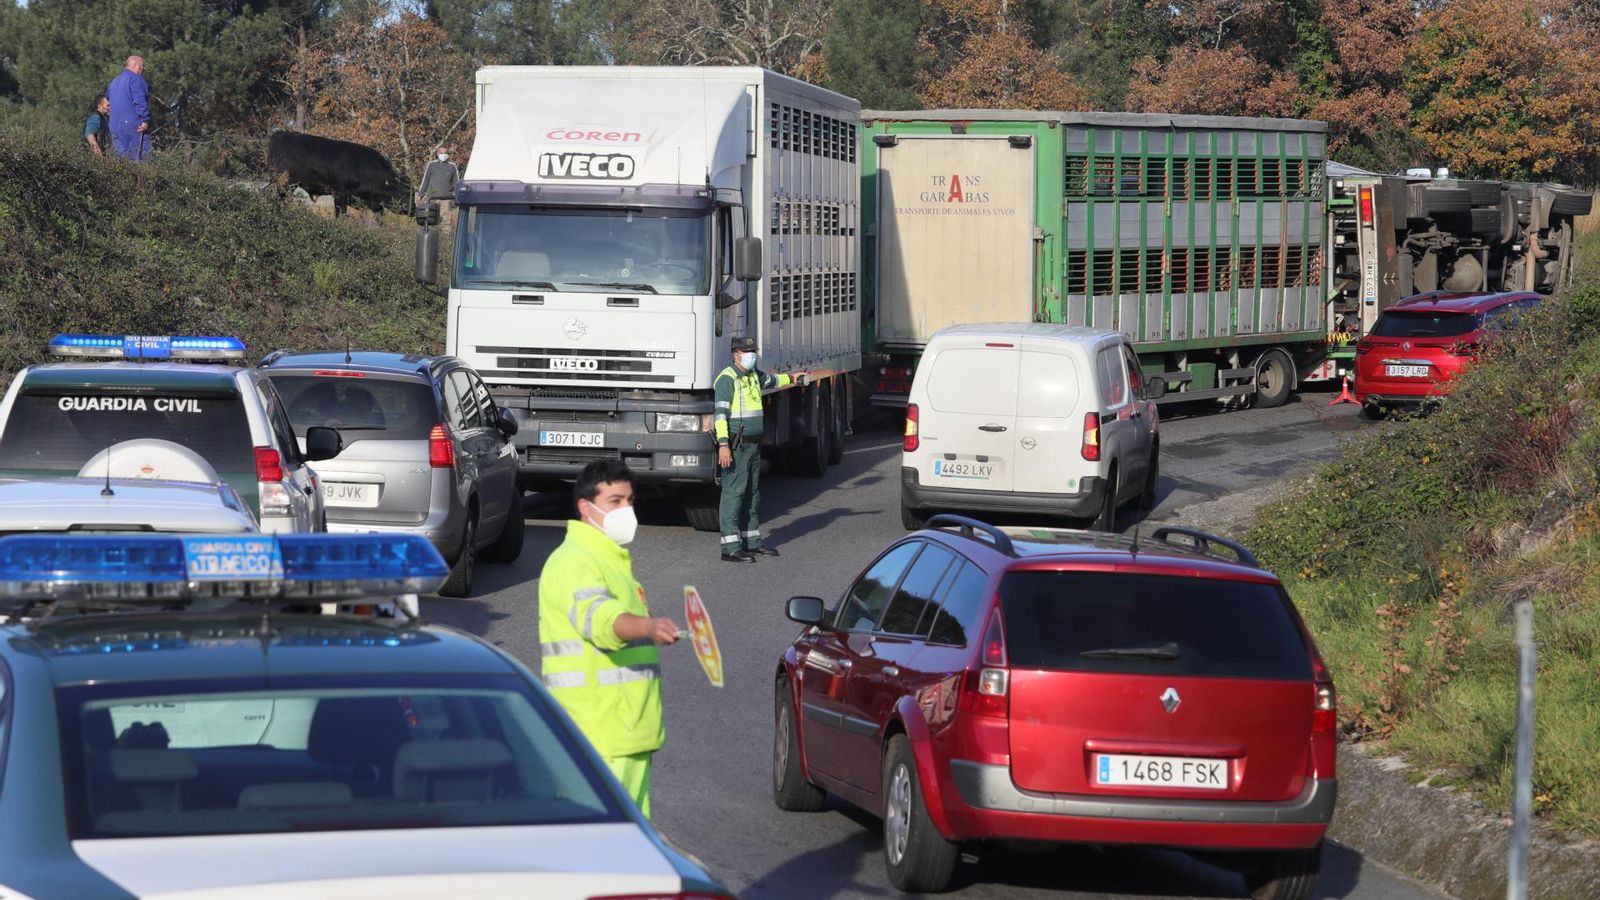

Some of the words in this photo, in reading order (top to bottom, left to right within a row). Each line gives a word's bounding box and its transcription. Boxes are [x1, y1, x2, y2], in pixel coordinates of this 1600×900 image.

[538, 154, 635, 179] IVECO
[549, 359, 599, 371] IVECO
[58, 396, 148, 411] GUARDIA
[153, 398, 203, 413] CIVIL
[548, 433, 575, 444] 3071
[579, 434, 601, 445] CJC
[942, 463, 969, 475] 4492
[972, 465, 993, 476] LKV
[338, 486, 362, 499] JVK
[1121, 759, 1174, 782] 1468
[1182, 762, 1221, 785] FSK
